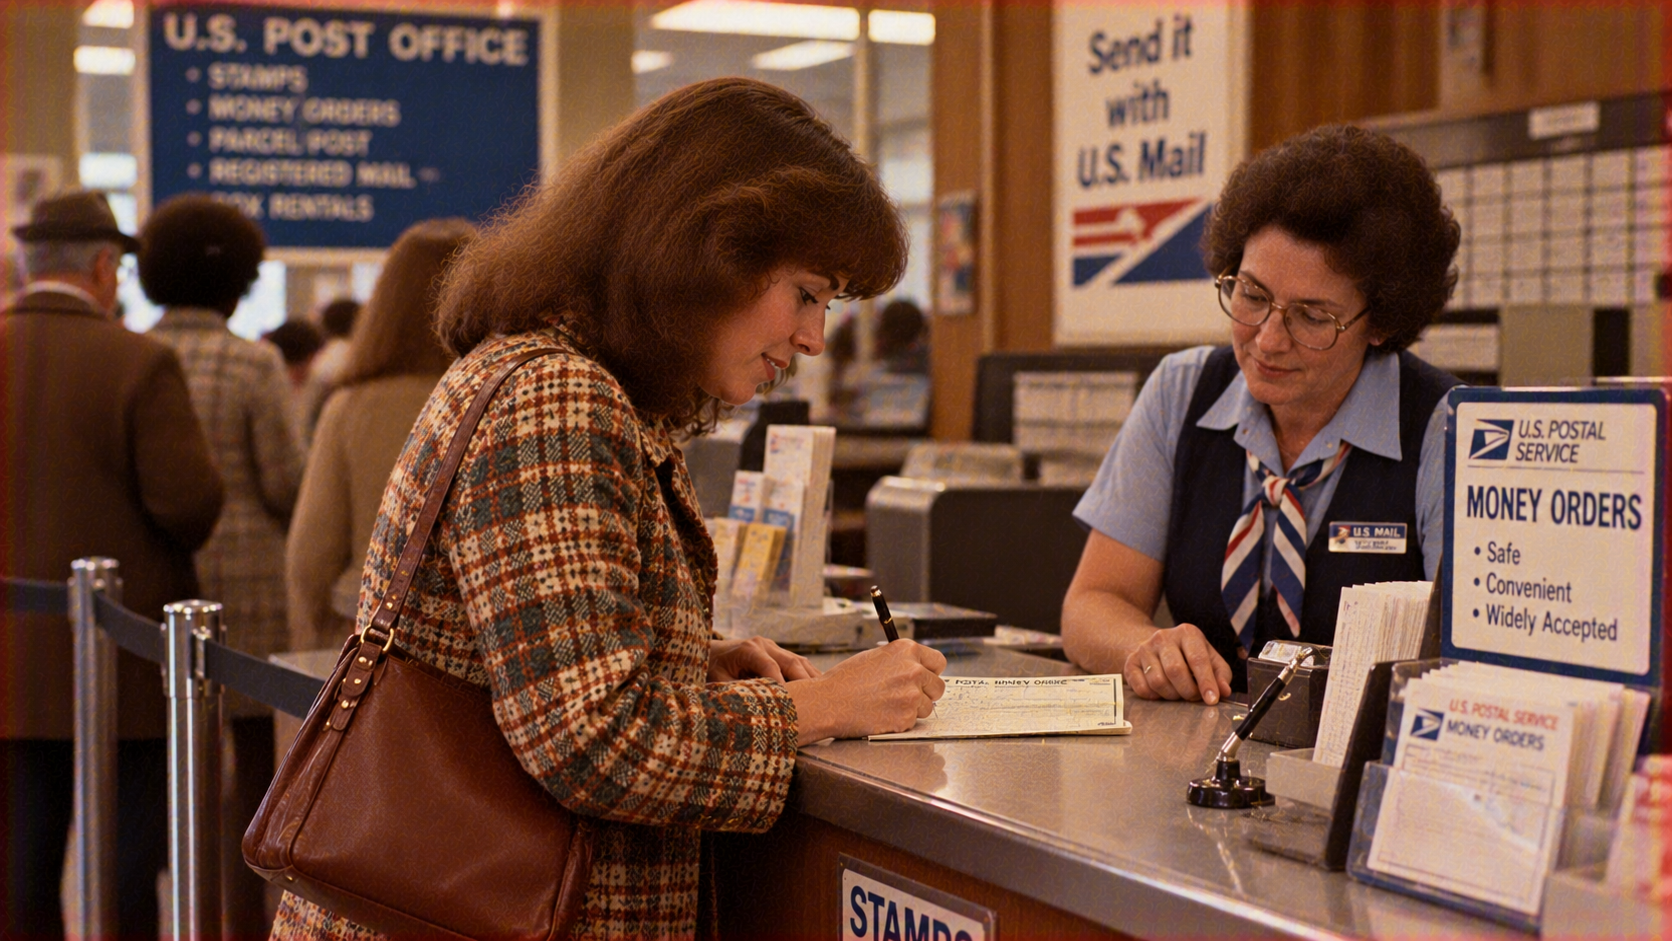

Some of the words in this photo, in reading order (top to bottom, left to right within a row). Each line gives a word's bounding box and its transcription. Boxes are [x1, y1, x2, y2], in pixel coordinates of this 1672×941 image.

[164, 13, 247, 53] U.S.
[264, 17, 375, 58] POST
[389, 23, 529, 66] OFFICE
[1088, 18, 1163, 75] Send
[1172, 13, 1193, 59] it
[208, 62, 308, 93] STAMPS
[208, 95, 297, 122] MONEY
[302, 99, 401, 127] ORDERS
[1106, 80, 1170, 127] with
[208, 127, 300, 154] PARCEL
[306, 130, 373, 156] POST
[208, 157, 352, 187] REGISTERED
[355, 161, 417, 189] MAIL
[1077, 143, 1129, 188] U.S.
[1138, 131, 1207, 181] Mail
[269, 193, 375, 222] RENTALS
[1518, 419, 1545, 439] U.S.
[1548, 420, 1606, 441] POSTAL
[1515, 442, 1580, 463] SERVICE
[1467, 485, 1543, 523] MONEY
[1551, 489, 1642, 530] ORDERS
[1487, 541, 1521, 565] Safe
[1486, 572, 1572, 603] Convenient
[1486, 603, 1537, 636] Widely
[1542, 612, 1617, 643] Accepted
[1471, 702, 1510, 722] POSTAL
[1513, 709, 1559, 731] SERVICE
[1446, 719, 1490, 739] MONEY
[1493, 727, 1545, 751] ORDERS
[850, 885, 973, 941] STAM
